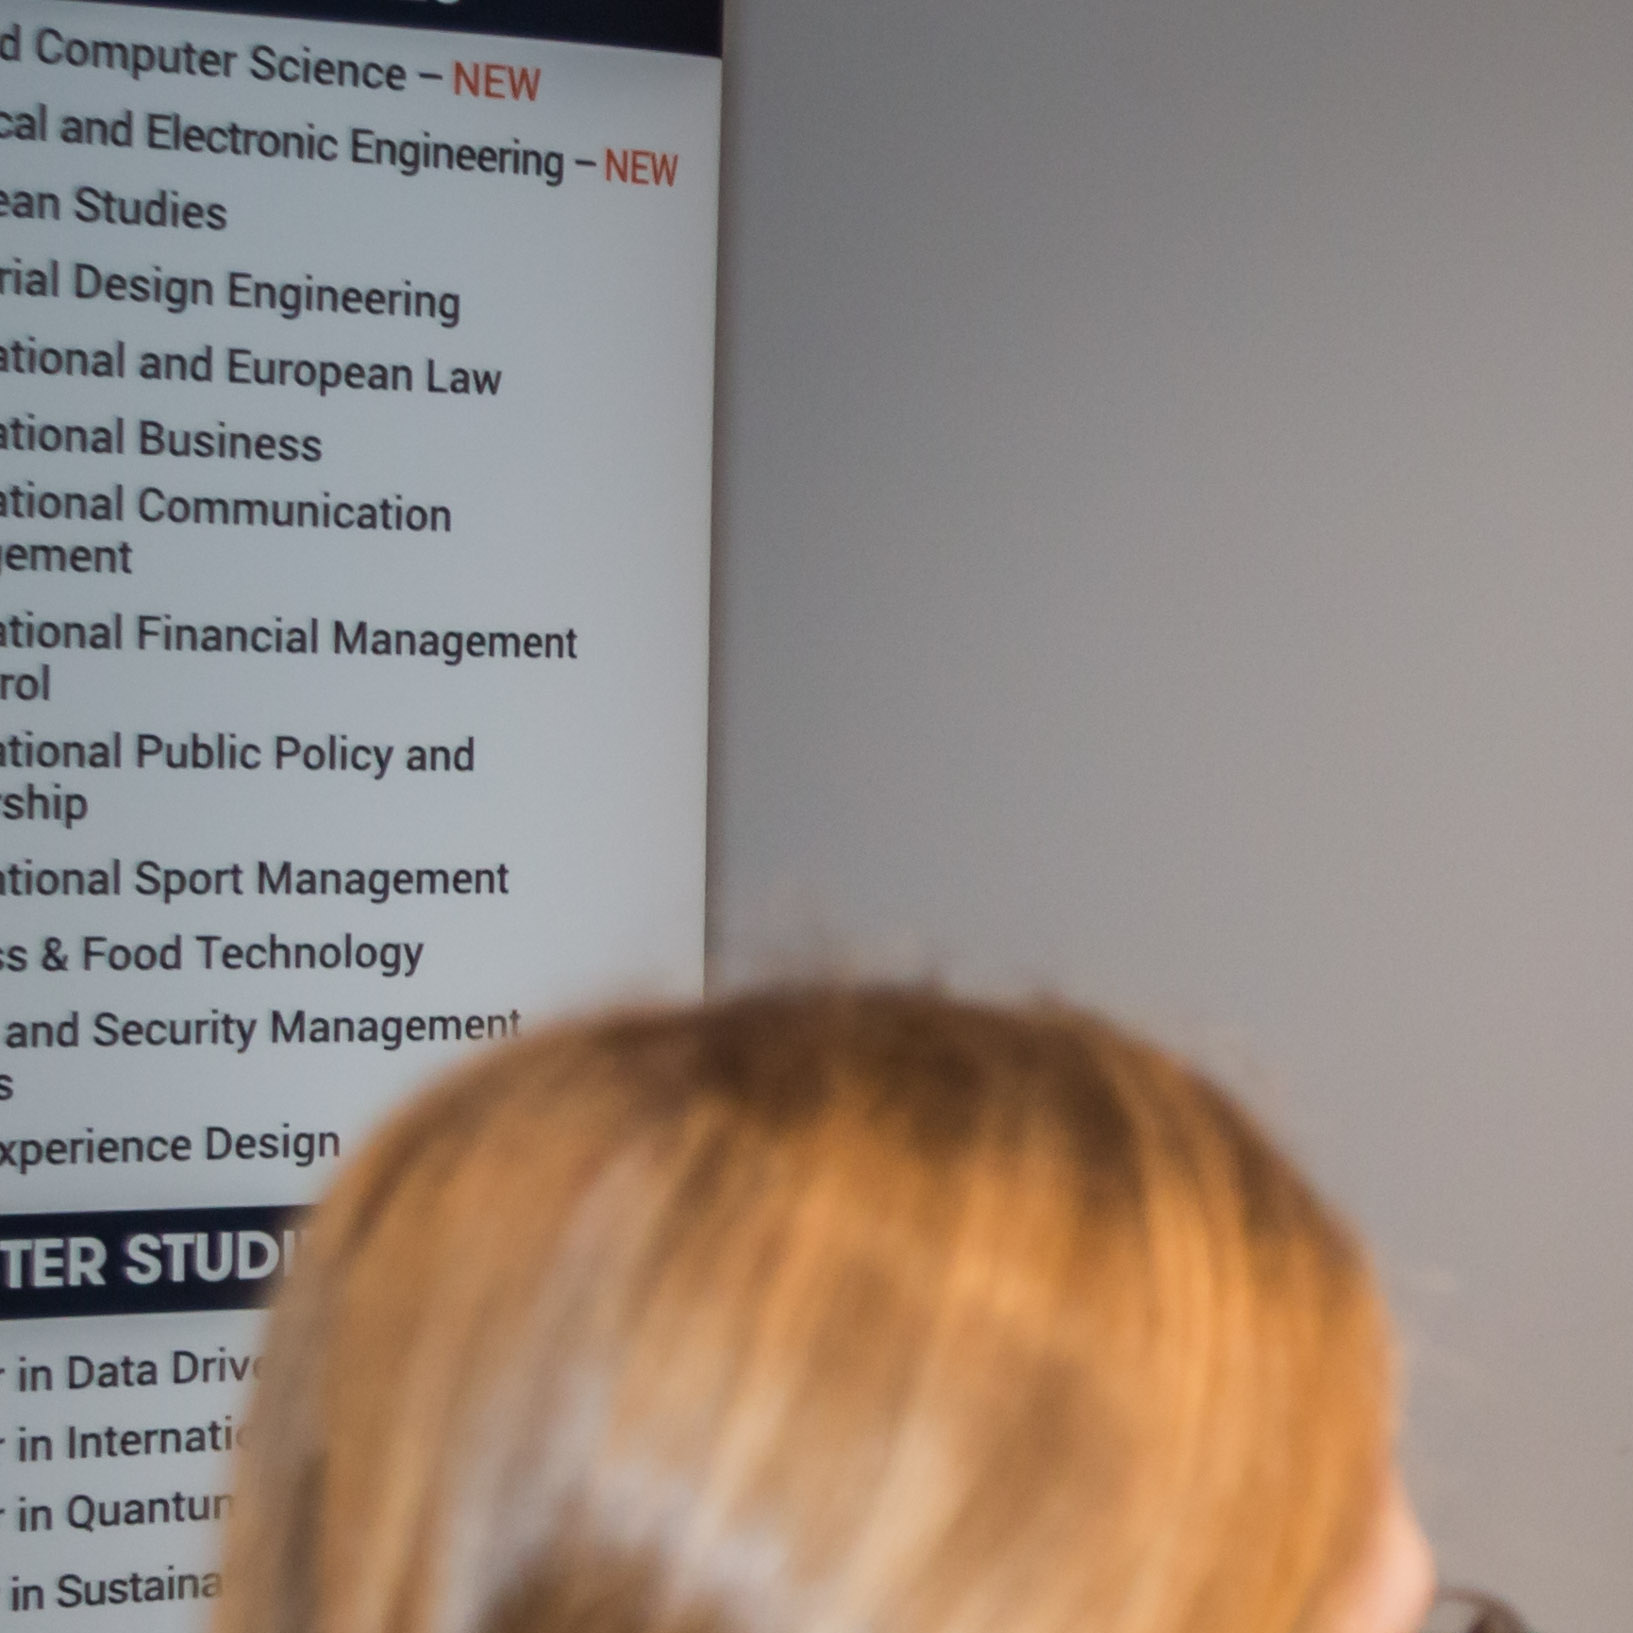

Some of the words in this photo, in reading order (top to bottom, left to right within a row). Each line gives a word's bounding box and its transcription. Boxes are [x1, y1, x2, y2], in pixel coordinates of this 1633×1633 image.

[35, 27, 237, 80] Computer
[250, 45, 406, 91] Science
[455, 61, 541, 101] NEW
[60, 110, 132, 147] and
[147, 113, 338, 161] Electronic
[352, 128, 563, 187] Engineering
[606, 149, 678, 187] NEW
[74, 186, 226, 230] Studies
[74, 263, 213, 313] Design
[229, 272, 459, 328] Engineering
[139, 345, 212, 382] and
[228, 348, 412, 396] European
[428, 359, 501, 395] Law
[140, 420, 321, 462] Business
[138, 487, 450, 531] Communication
[0, 542, 132, 574] ement
[137, 614, 317, 653] Financial
[334, 620, 577, 666] Management
[0, 731, 121, 768] tional
[137, 733, 261, 769] Public
[276, 735, 393, 780] Policy
[407, 737, 474, 771] and
[0, 783, 88, 829] ship
[0, 859, 120, 896] tional
[135, 861, 243, 904] Sport
[258, 861, 509, 904] Management
[0, 946, 27, 972] s
[41, 937, 68, 971] &
[83, 934, 181, 971] Food
[195, 933, 424, 977] Technology
[5, 1011, 78, 1048] and
[93, 1009, 256, 1053] Security
[272, 1010, 523, 1050] Management
[206, 1126, 339, 1167] Design
[0, 1236, 107, 1289] TER
[18, 1355, 54, 1392] in
[67, 1353, 159, 1390] Data
[17, 1427, 53, 1462] in
[18, 1496, 53, 1532] in
[11, 1576, 44, 1612] in
